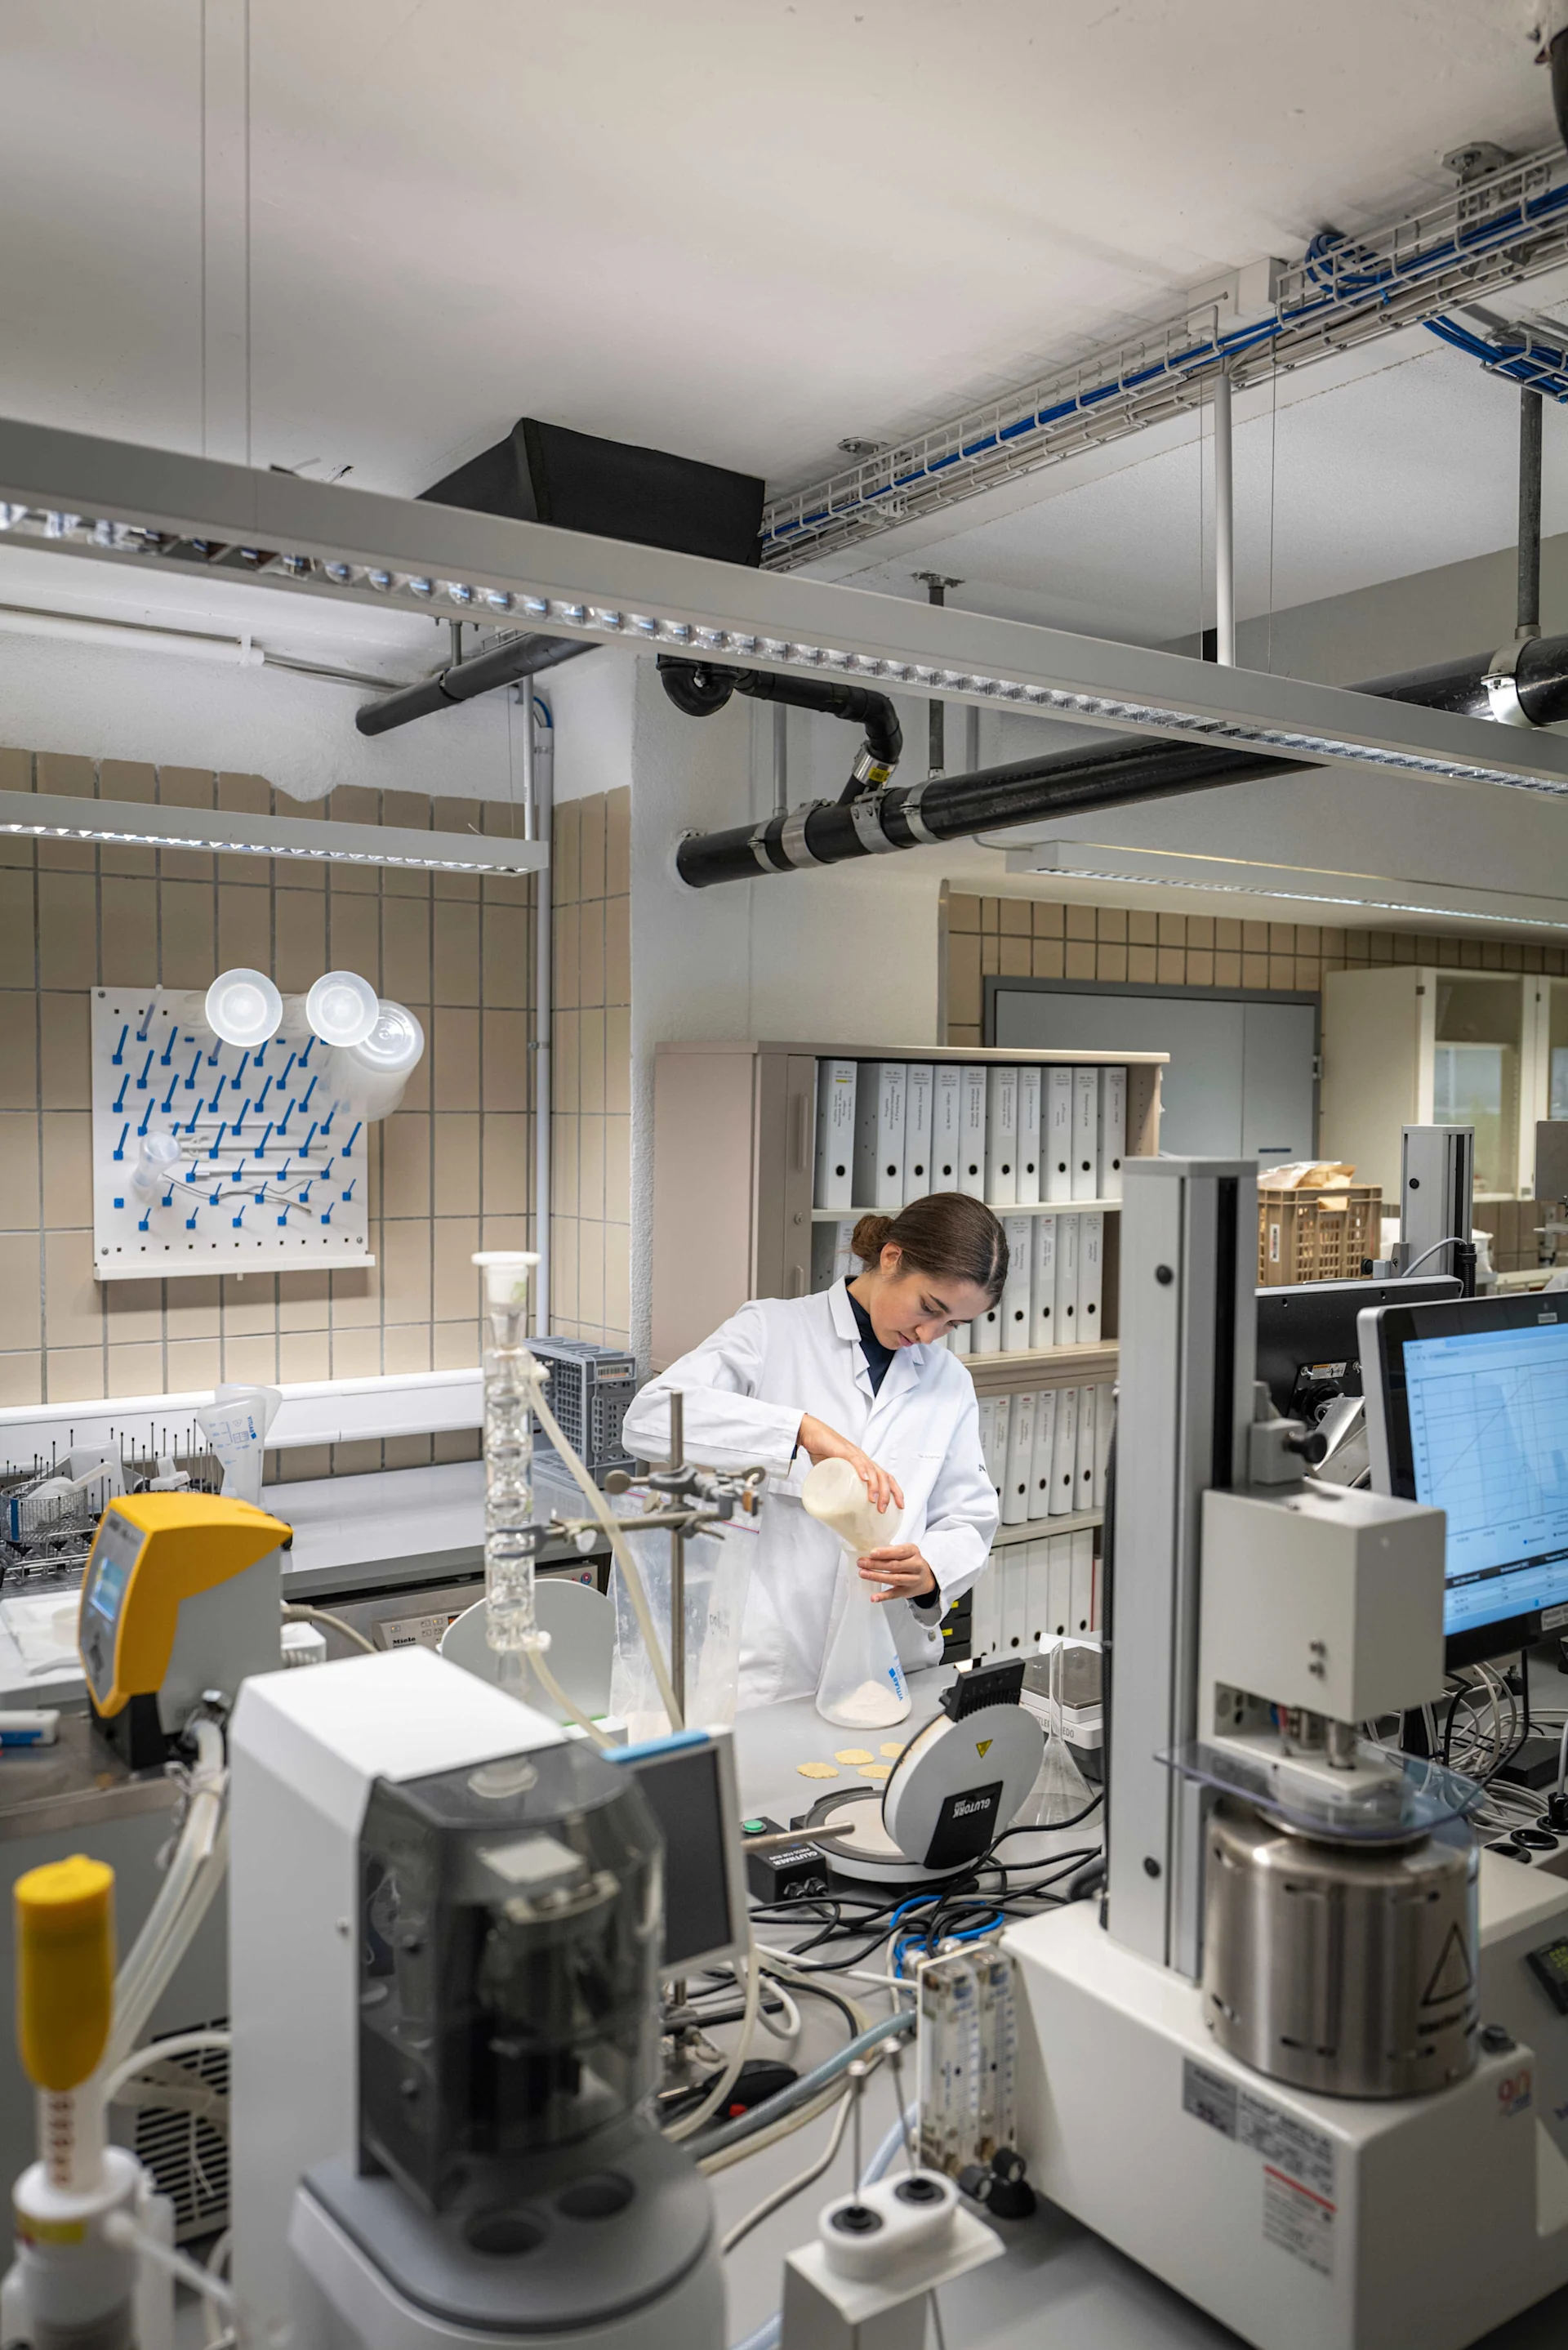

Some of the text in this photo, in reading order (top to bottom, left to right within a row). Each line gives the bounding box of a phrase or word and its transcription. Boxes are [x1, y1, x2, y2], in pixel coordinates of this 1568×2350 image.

[392, 1637, 416, 1645] Miele
[893, 1676, 903, 1701] VITLAB
[952, 1797, 991, 1818] GLUTORK
[773, 1850, 817, 1866] GLUTIMER
